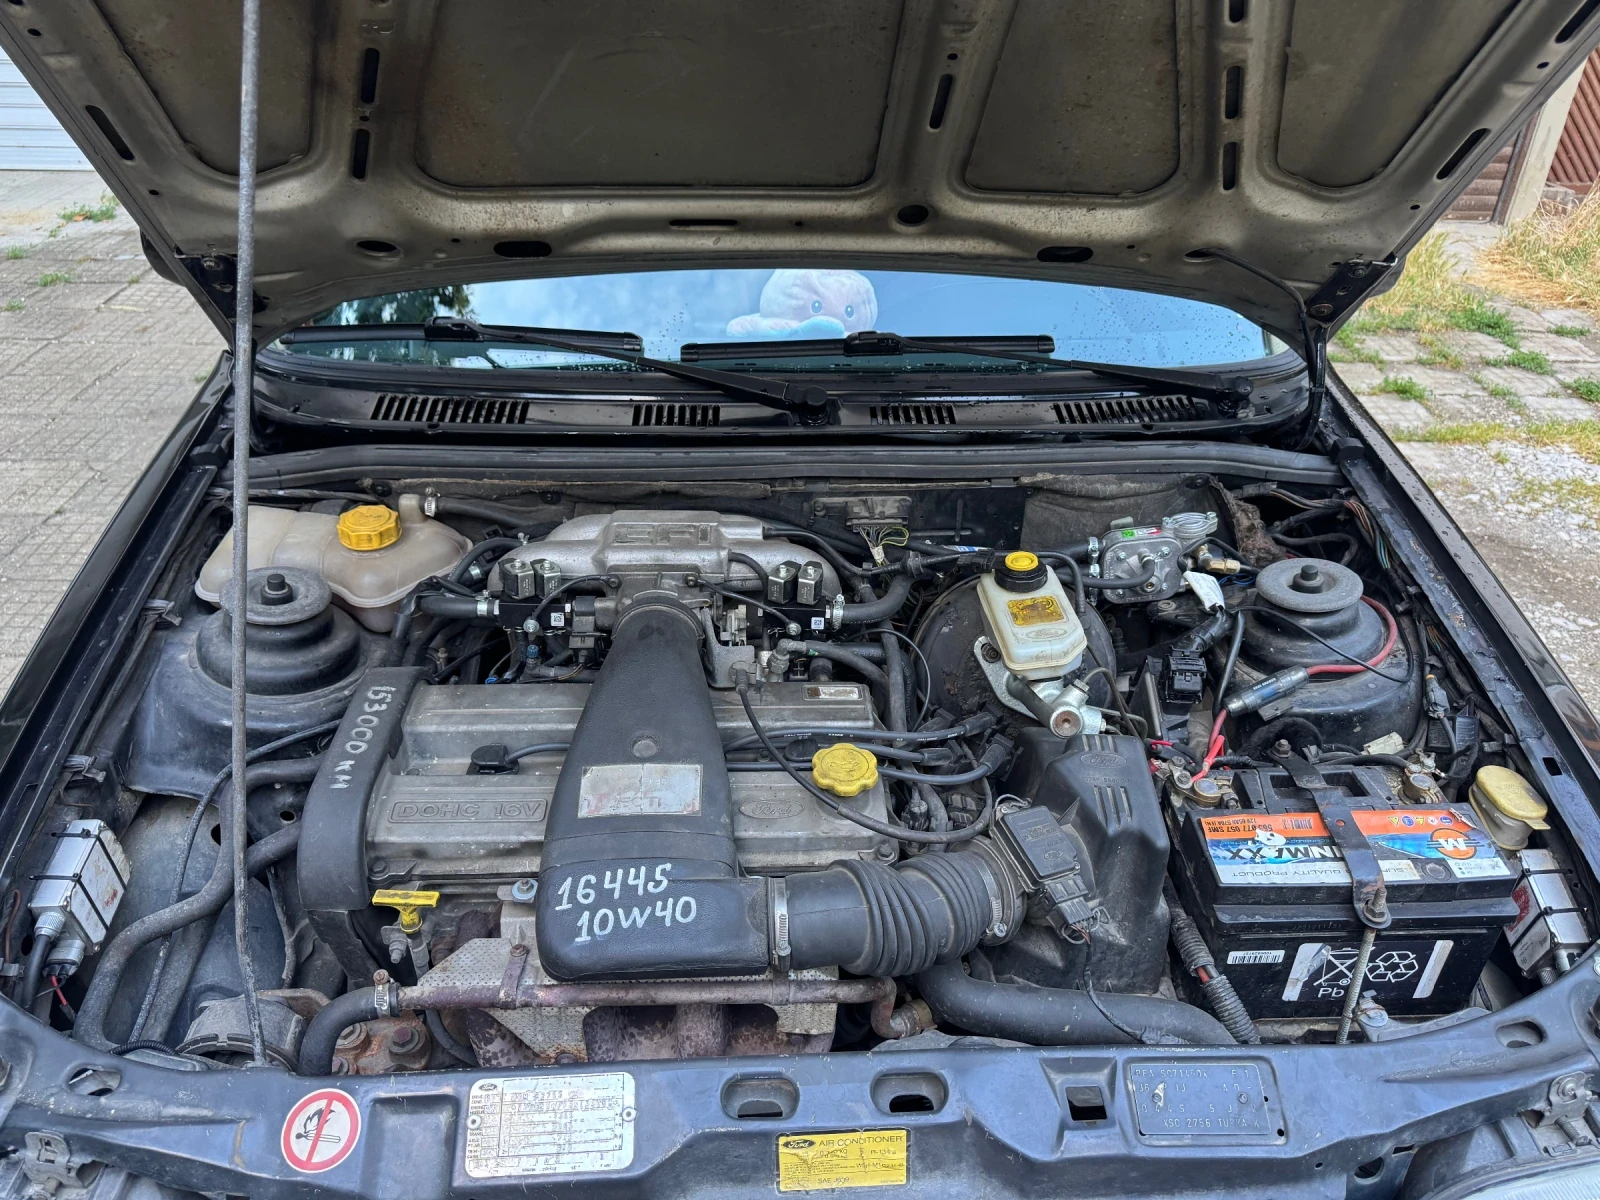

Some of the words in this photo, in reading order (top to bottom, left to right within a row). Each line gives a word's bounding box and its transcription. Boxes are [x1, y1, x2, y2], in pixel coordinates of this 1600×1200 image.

[613, 523, 711, 545] EFI
[345, 685, 397, 755] 153000
[398, 804, 481, 818] DOHC
[494, 803, 543, 817] 16V
[752, 801, 793, 816] Ford
[1226, 825, 1240, 833] 057
[1242, 824, 1257, 832] 077
[1231, 869, 1288, 877] PRODUCT
[555, 863, 672, 911] 16445
[1317, 987, 1345, 998] Pb
[788, 1139, 810, 1149] Ford
[818, 1139, 835, 1147] AIR
[837, 1135, 903, 1147] CONDITIONER
